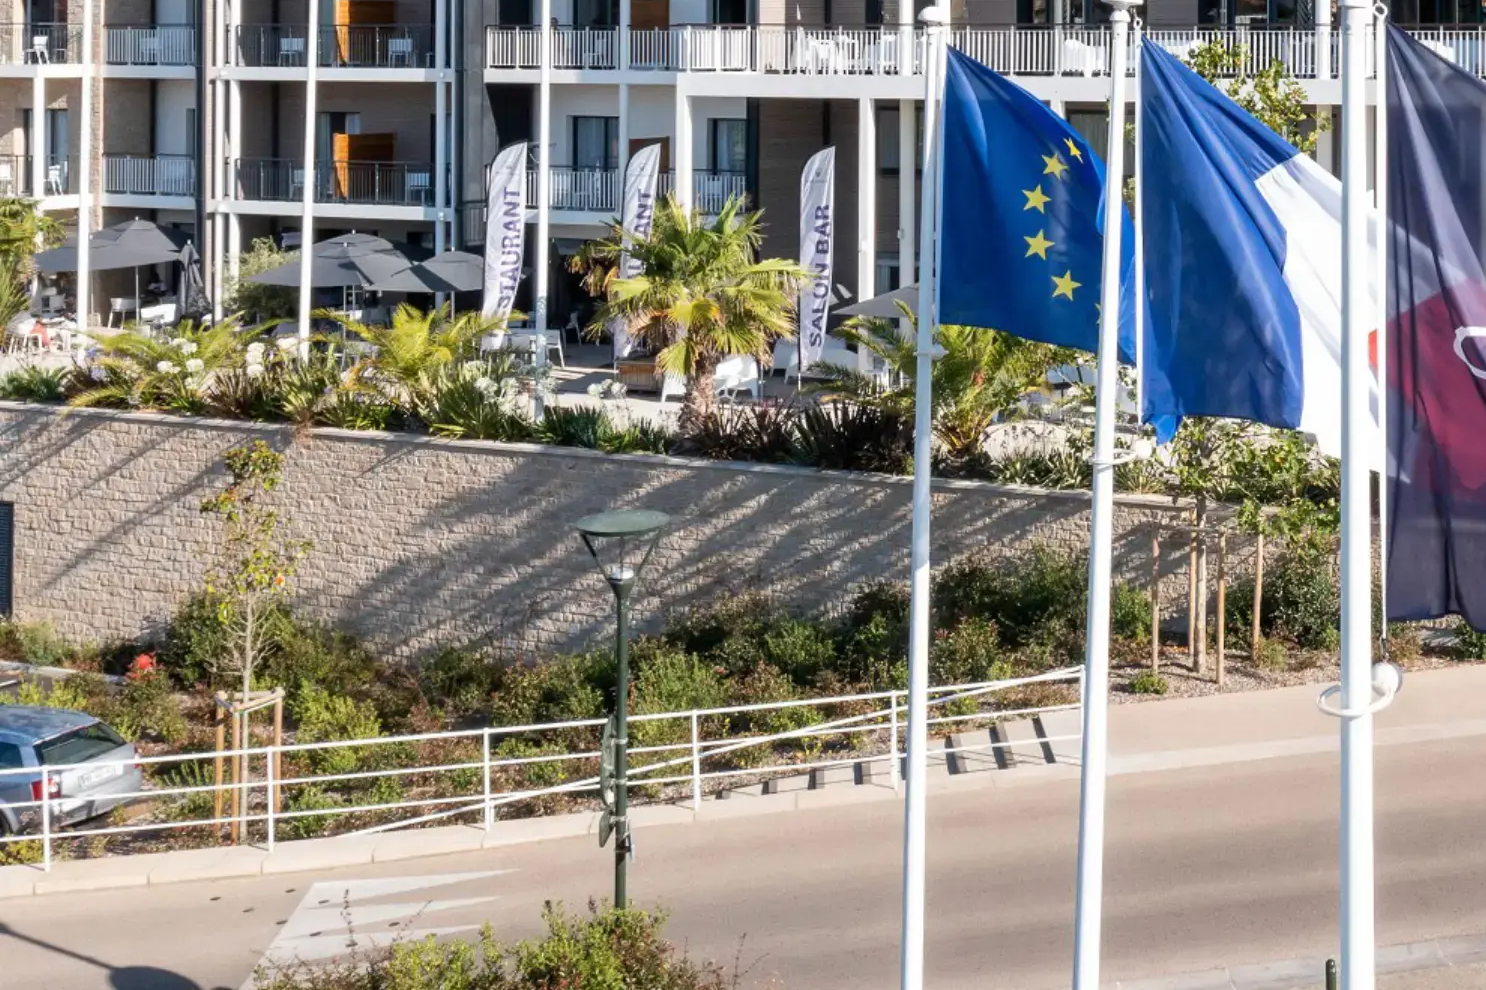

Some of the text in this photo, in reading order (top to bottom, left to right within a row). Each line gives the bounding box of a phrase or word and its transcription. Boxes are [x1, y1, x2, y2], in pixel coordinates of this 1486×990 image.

[488, 187, 521, 339] STAURANT
[814, 204, 831, 255] BAR
[809, 262, 830, 348] SALON
